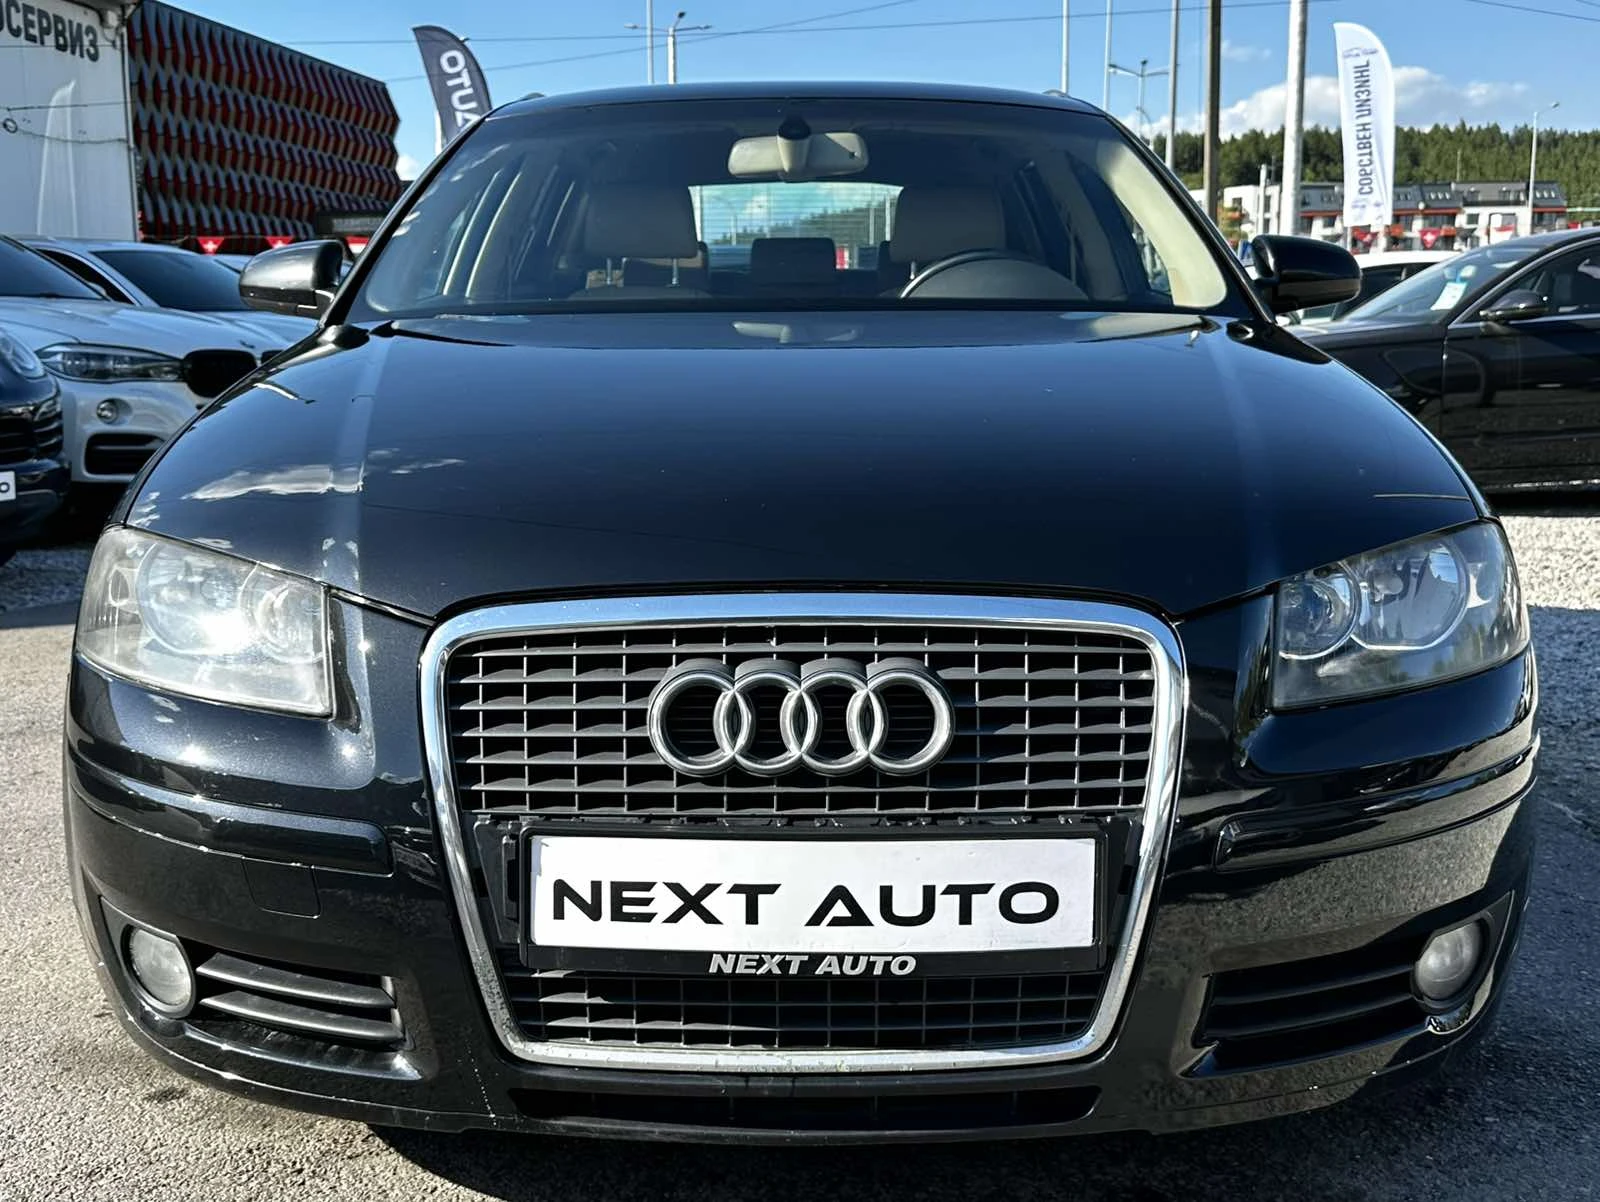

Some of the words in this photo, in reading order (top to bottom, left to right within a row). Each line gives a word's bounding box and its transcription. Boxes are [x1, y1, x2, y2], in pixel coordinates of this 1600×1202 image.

[0, 0, 100, 62] СЕРВИЗ
[553, 878, 782, 925] NEXT
[804, 881, 1059, 927] AUTO
[708, 953, 808, 976] NEXT
[815, 955, 917, 976] AUTO
